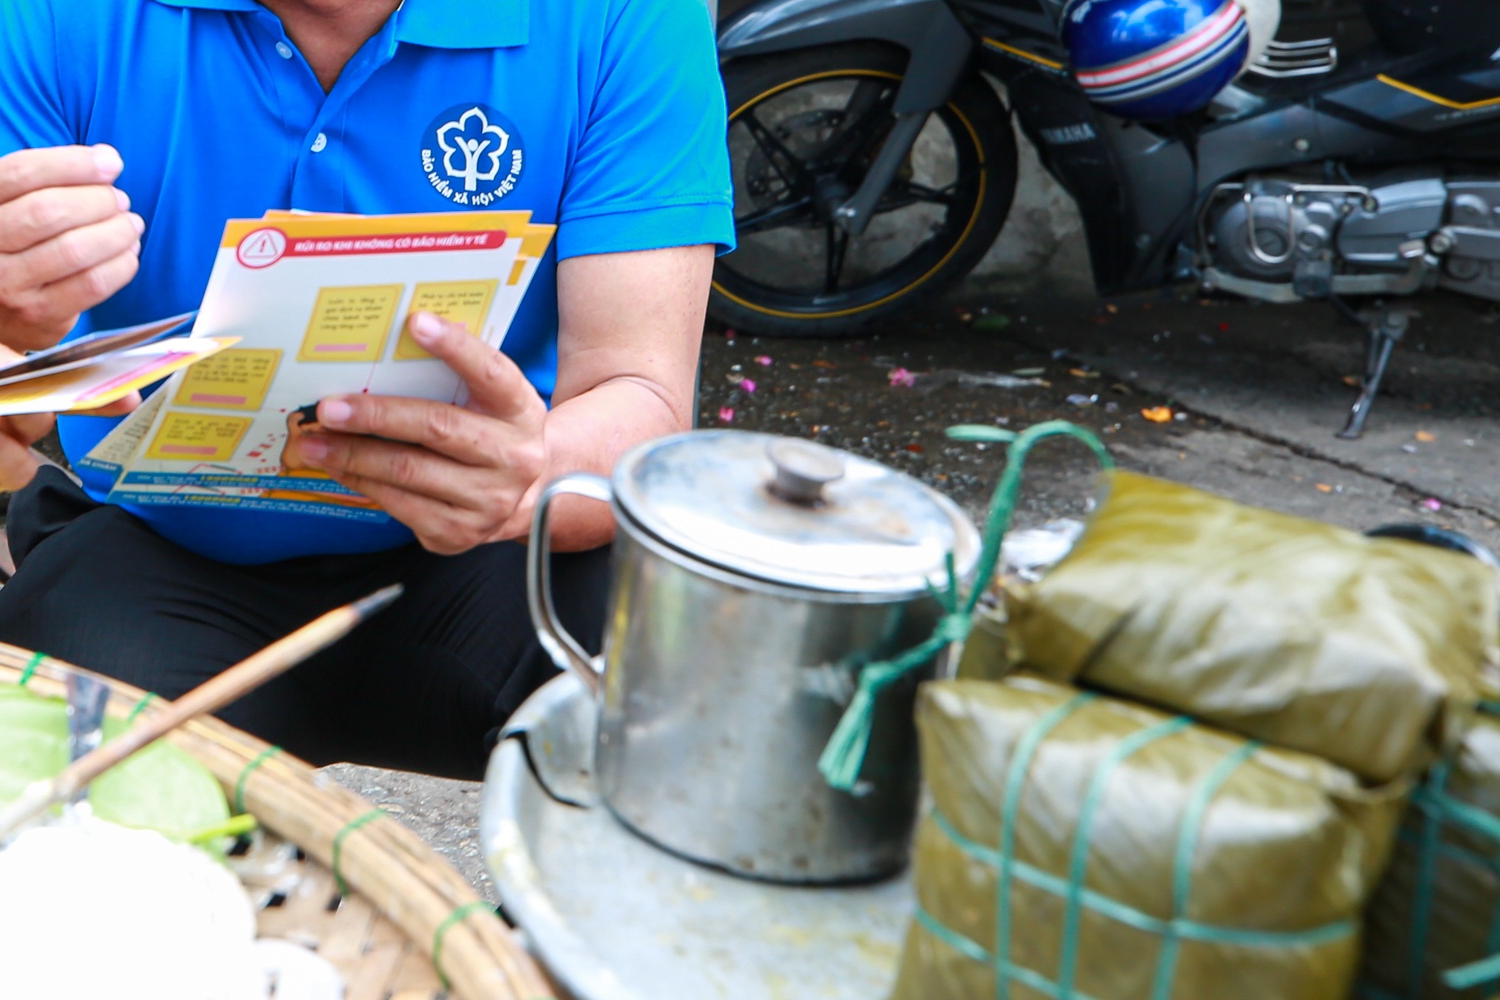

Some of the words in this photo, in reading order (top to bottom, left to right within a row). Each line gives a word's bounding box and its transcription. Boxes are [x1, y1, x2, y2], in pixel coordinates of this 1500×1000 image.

[421, 149, 436, 173] BẢO
[510, 149, 523, 175] NAM
[427, 171, 453, 199] HIỂM
[493, 173, 517, 198] VIỆT
[452, 191, 469, 205] XÃ
[471, 191, 494, 206] HỘI
[333, 240, 352, 251] KHI
[353, 237, 394, 250] KHÔNG
[436, 233, 464, 247] HIỂM
[473, 233, 489, 246] TẾ
